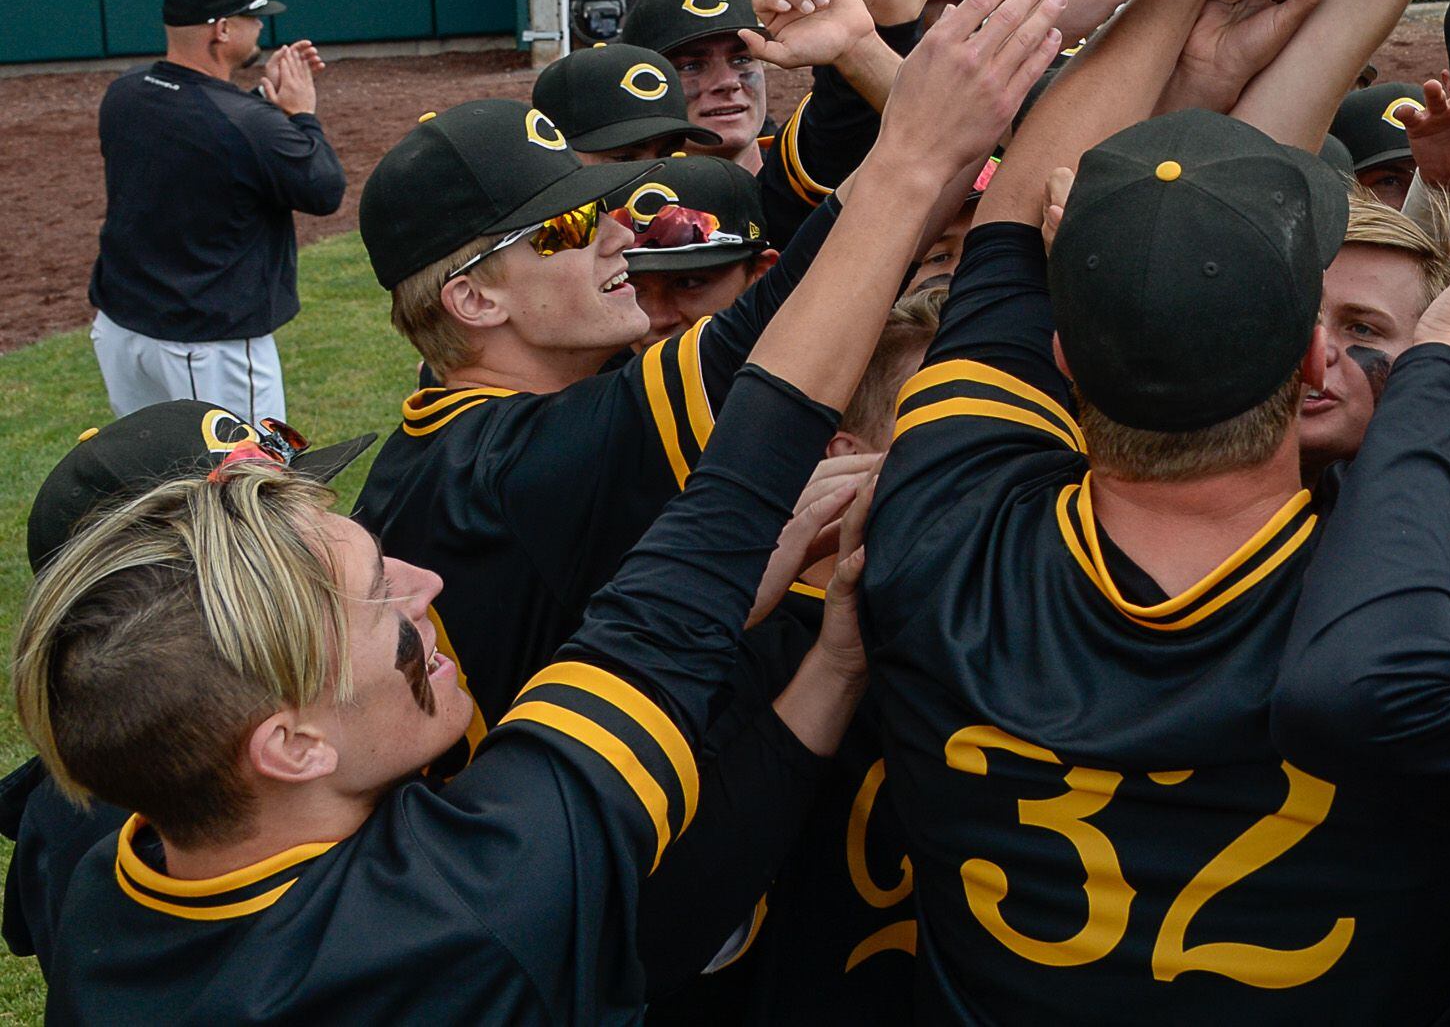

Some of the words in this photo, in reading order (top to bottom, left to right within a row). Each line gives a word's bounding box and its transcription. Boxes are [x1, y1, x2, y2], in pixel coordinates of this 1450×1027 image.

[620, 63, 669, 100] C
[525, 108, 568, 151] C
[625, 182, 680, 225] C
[201, 409, 261, 453] C
[944, 724, 1355, 989] 32
